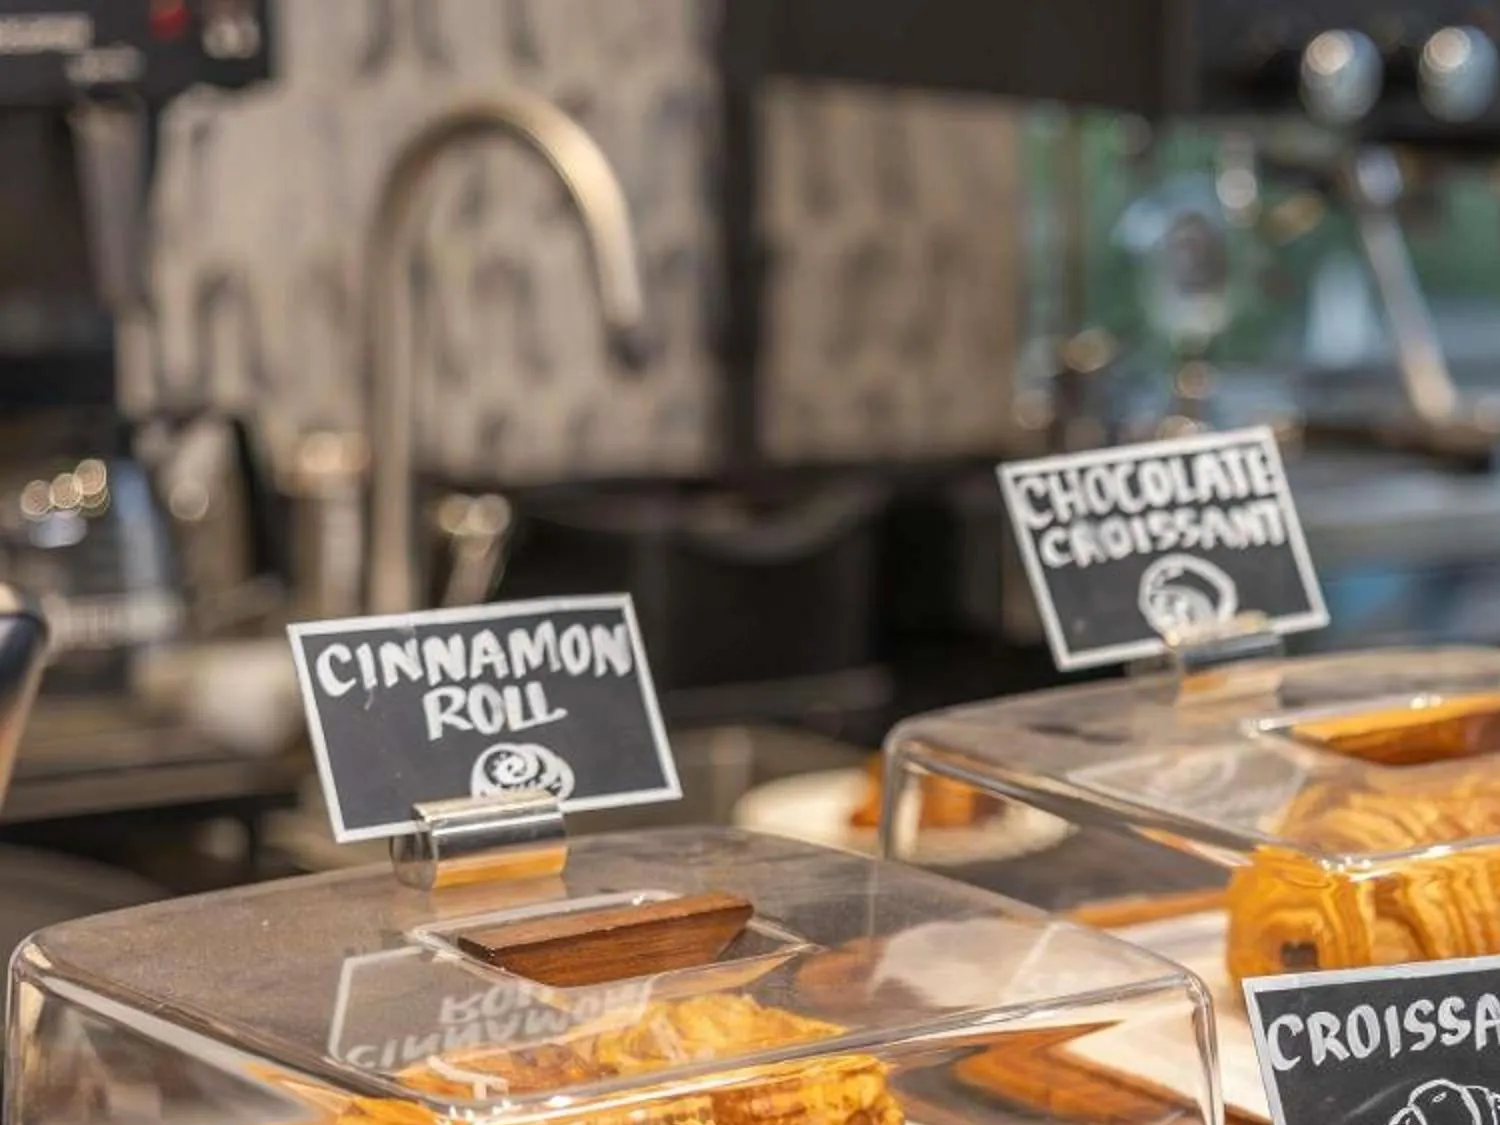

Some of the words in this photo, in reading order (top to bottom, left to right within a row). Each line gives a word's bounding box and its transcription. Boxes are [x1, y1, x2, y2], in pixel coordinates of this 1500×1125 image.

[1019, 449, 1278, 529] CHOCOLATE
[1040, 499, 1285, 567] CROISSANT
[315, 620, 635, 697] CINNAMON
[423, 682, 568, 741] ROLL
